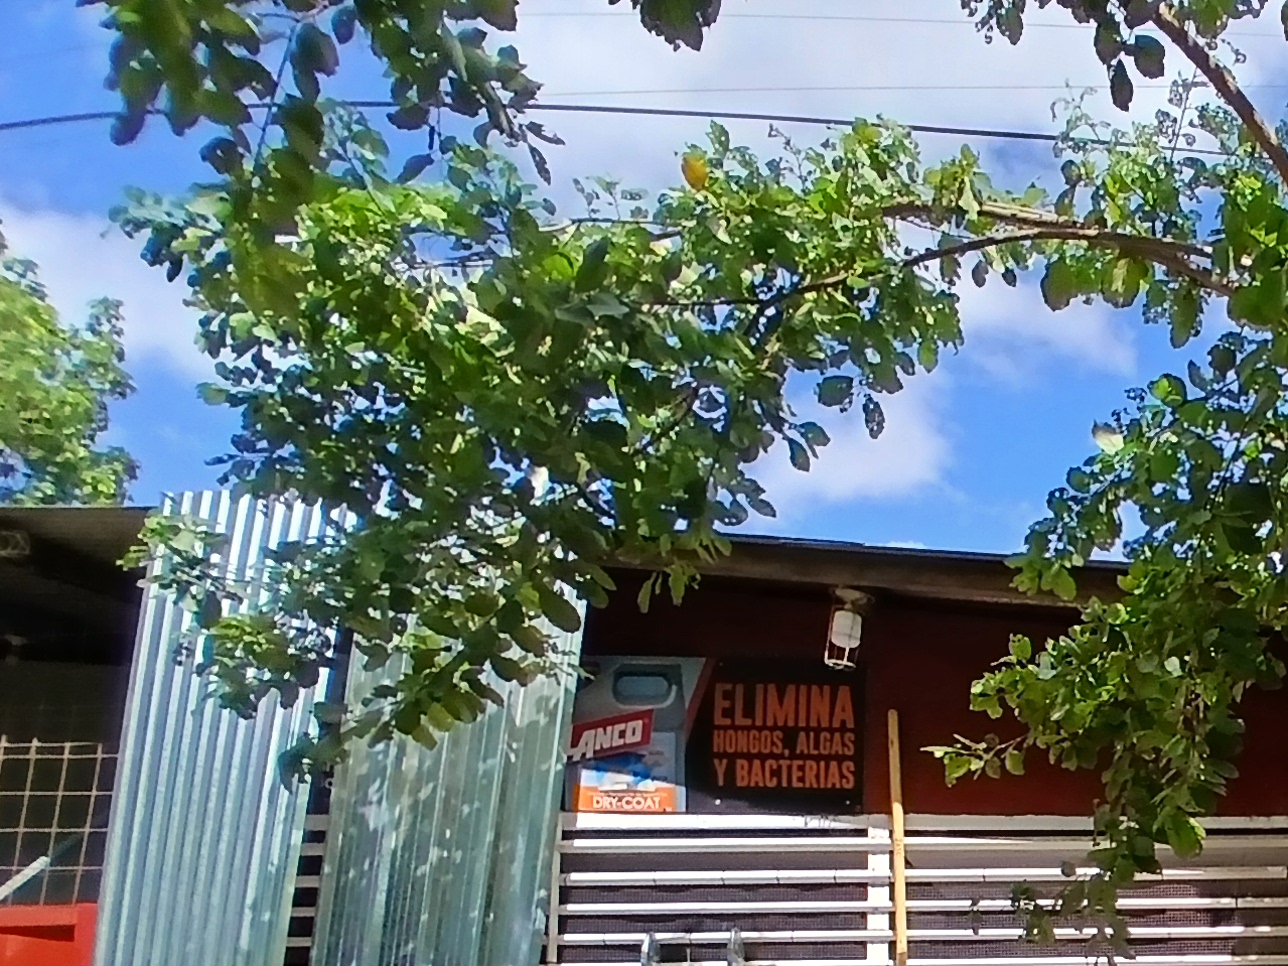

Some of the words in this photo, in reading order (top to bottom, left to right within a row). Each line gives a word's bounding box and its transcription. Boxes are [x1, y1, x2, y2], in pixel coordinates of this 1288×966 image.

[713, 683, 855, 729] ELIMINA
[713, 729, 790, 758] HONGOS,
[796, 731, 855, 756] ALGAS
[713, 758, 728, 787] Y
[736, 759, 855, 789] BACTERIAS
[592, 796, 661, 809] DRY-COAT
